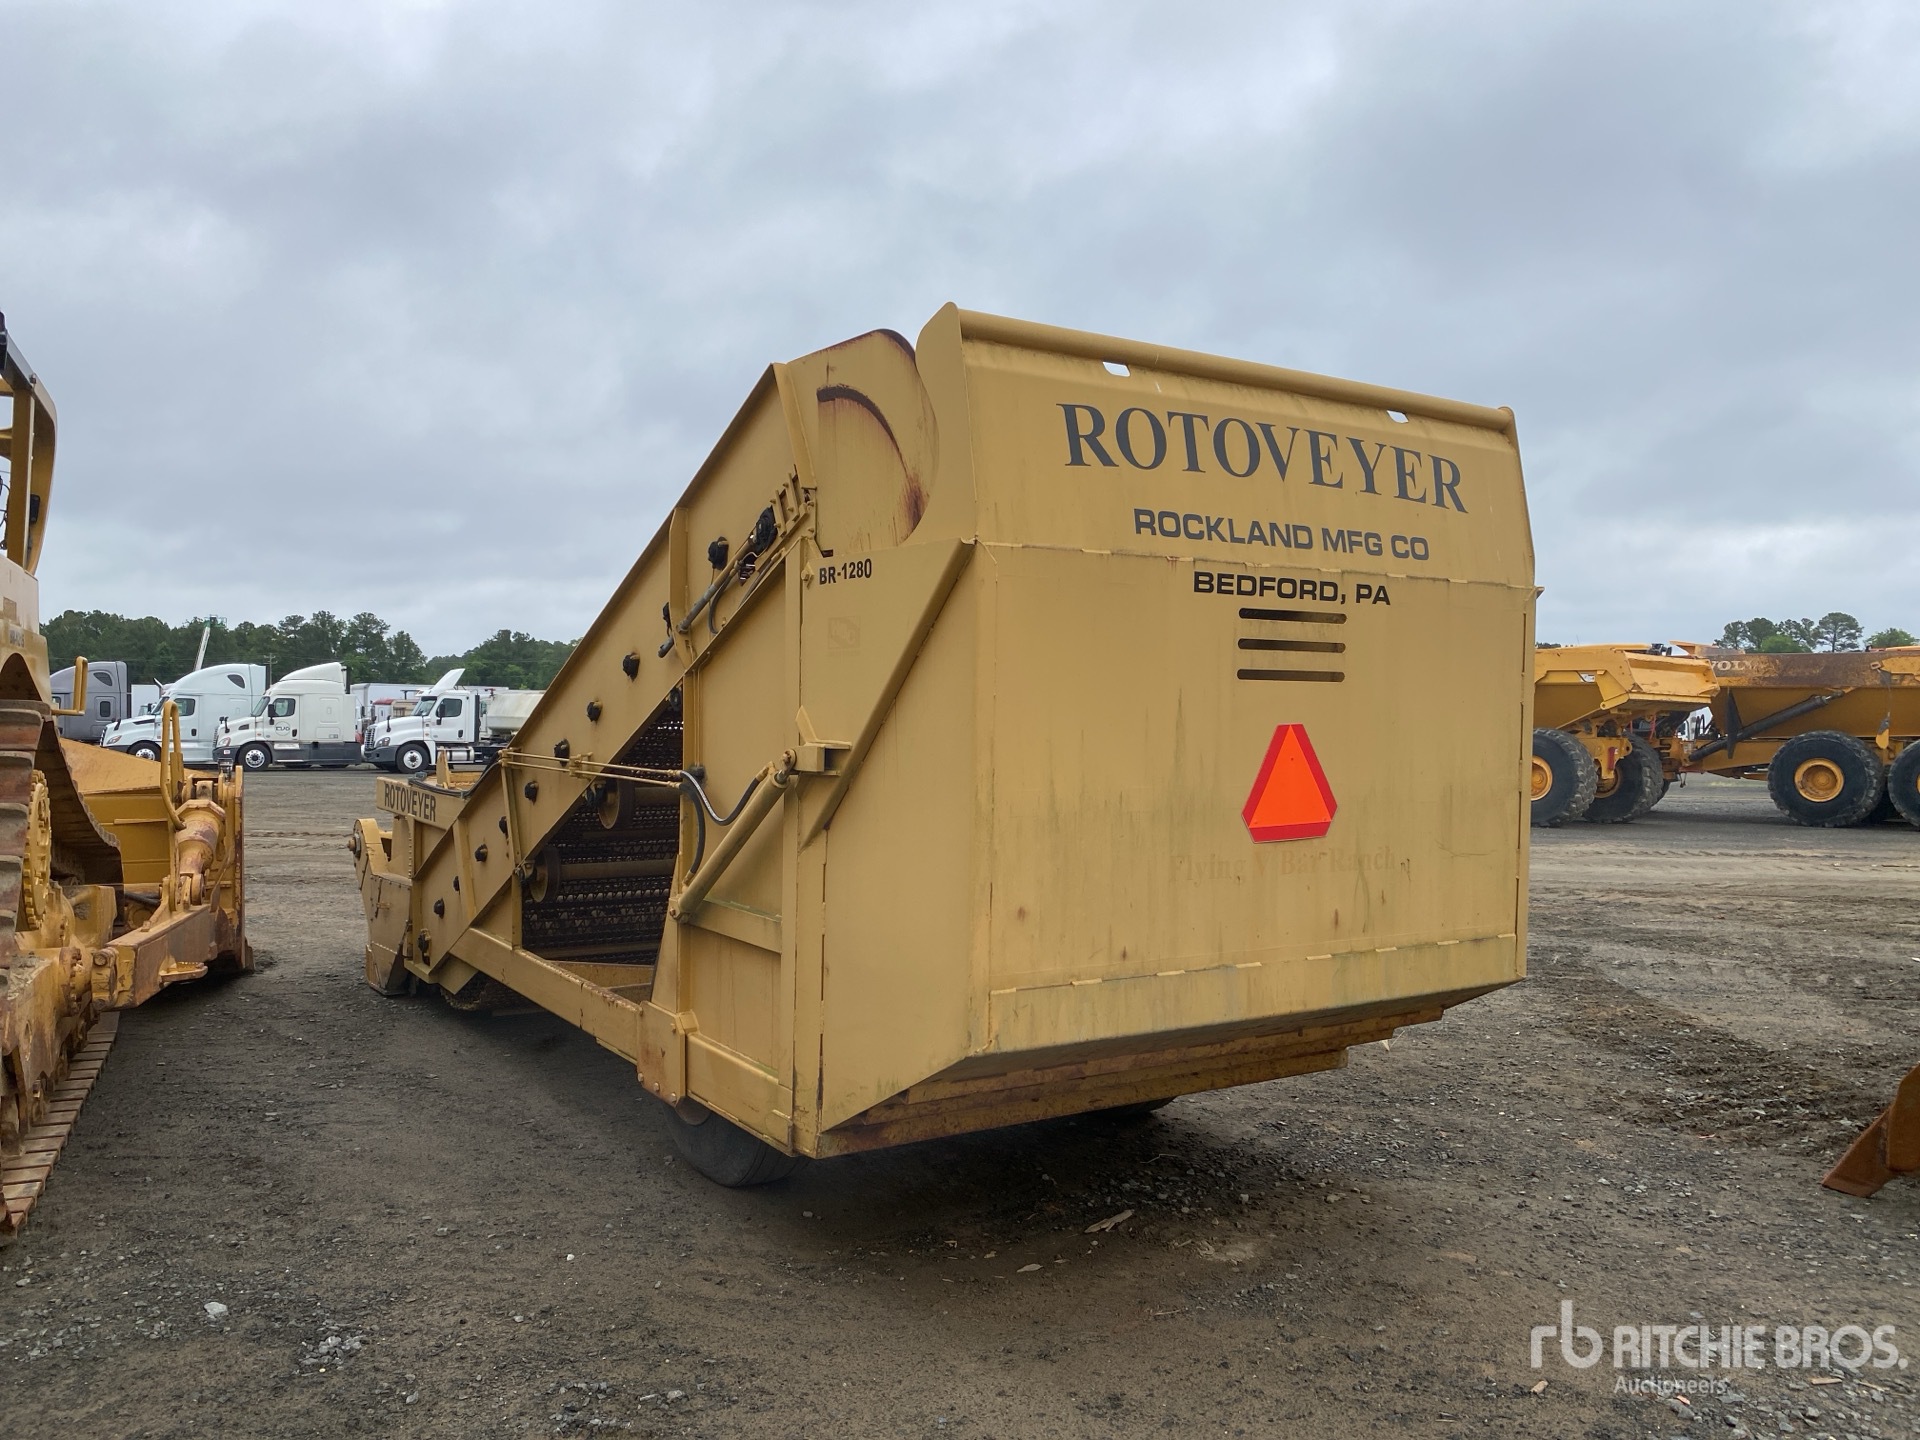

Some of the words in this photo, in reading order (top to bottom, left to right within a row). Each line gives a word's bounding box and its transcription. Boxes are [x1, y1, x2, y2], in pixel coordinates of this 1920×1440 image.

[1056, 403, 1468, 513] ROTOVEYER
[1133, 508, 1313, 550] ROCKLAND
[1322, 528, 1384, 556] MFG
[1391, 535, 1429, 561] CO
[819, 558, 873, 585] BR-1280
[1193, 571, 1346, 605] BEDFORD,
[1355, 584, 1391, 606] PA
[384, 783, 437, 822] ROTOVEYER
